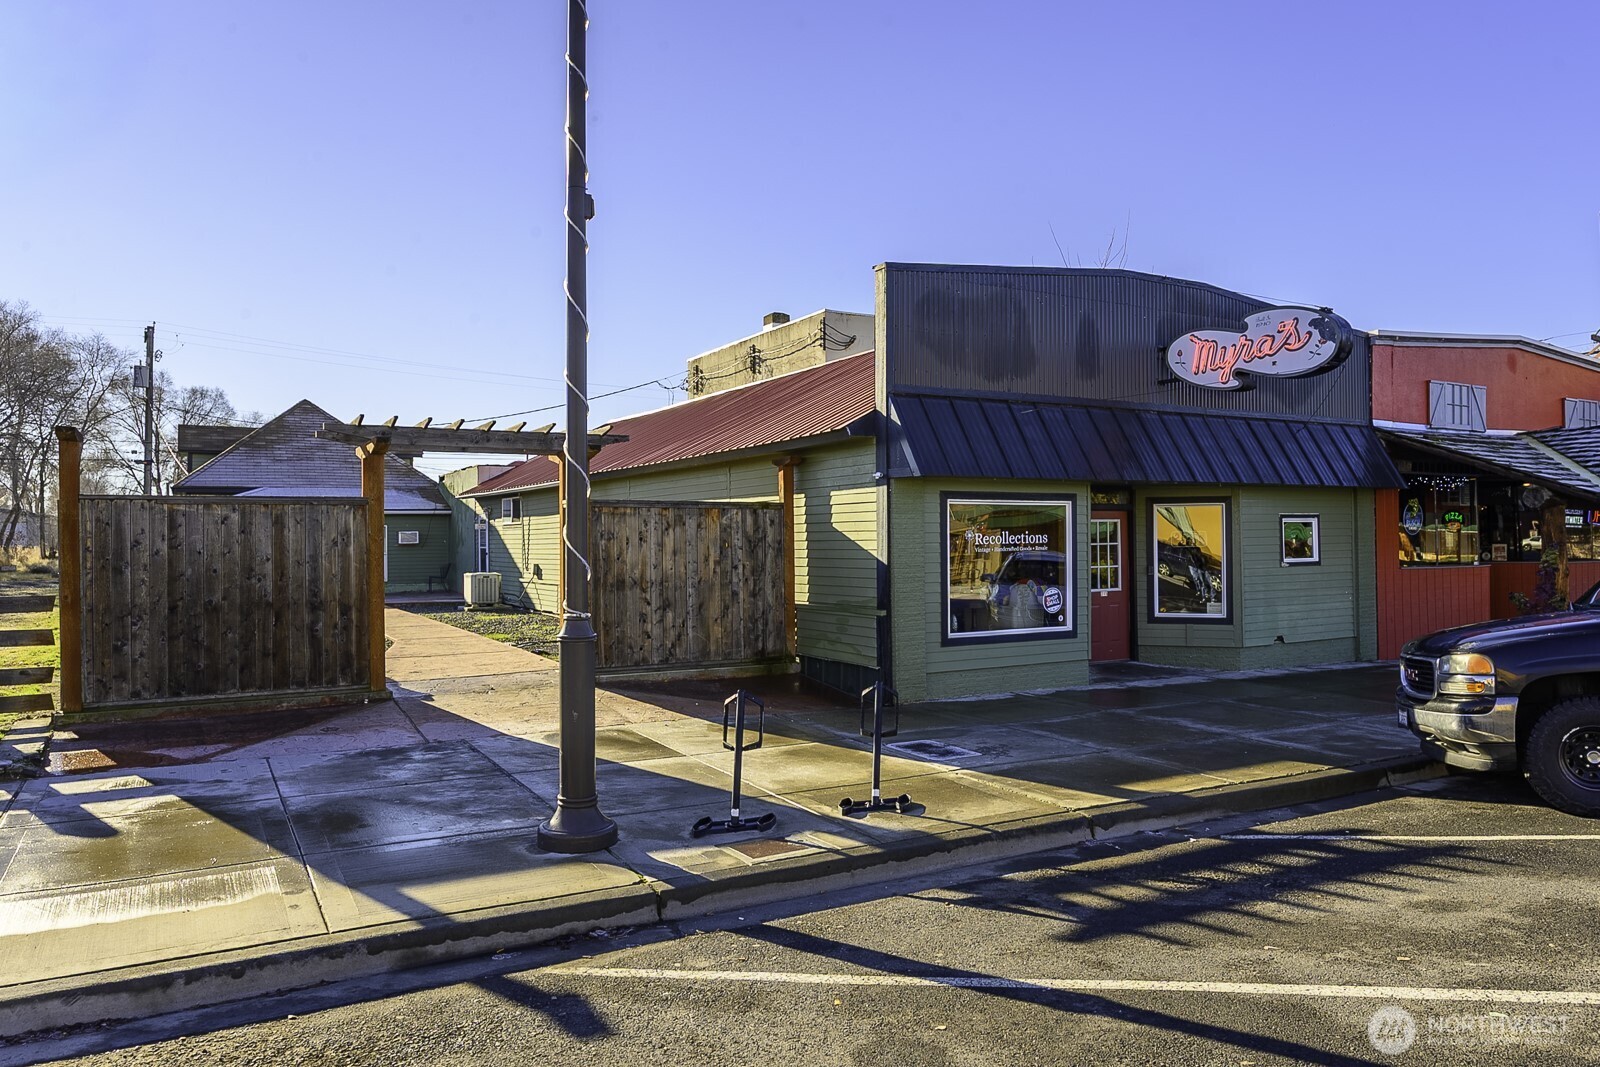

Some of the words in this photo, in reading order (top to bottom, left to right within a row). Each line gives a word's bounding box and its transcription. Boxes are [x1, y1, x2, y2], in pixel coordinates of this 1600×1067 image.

[1189, 317, 1312, 384] Myra's
[1445, 512, 1463, 522] PIZZA
[975, 530, 1048, 545] Recollections
